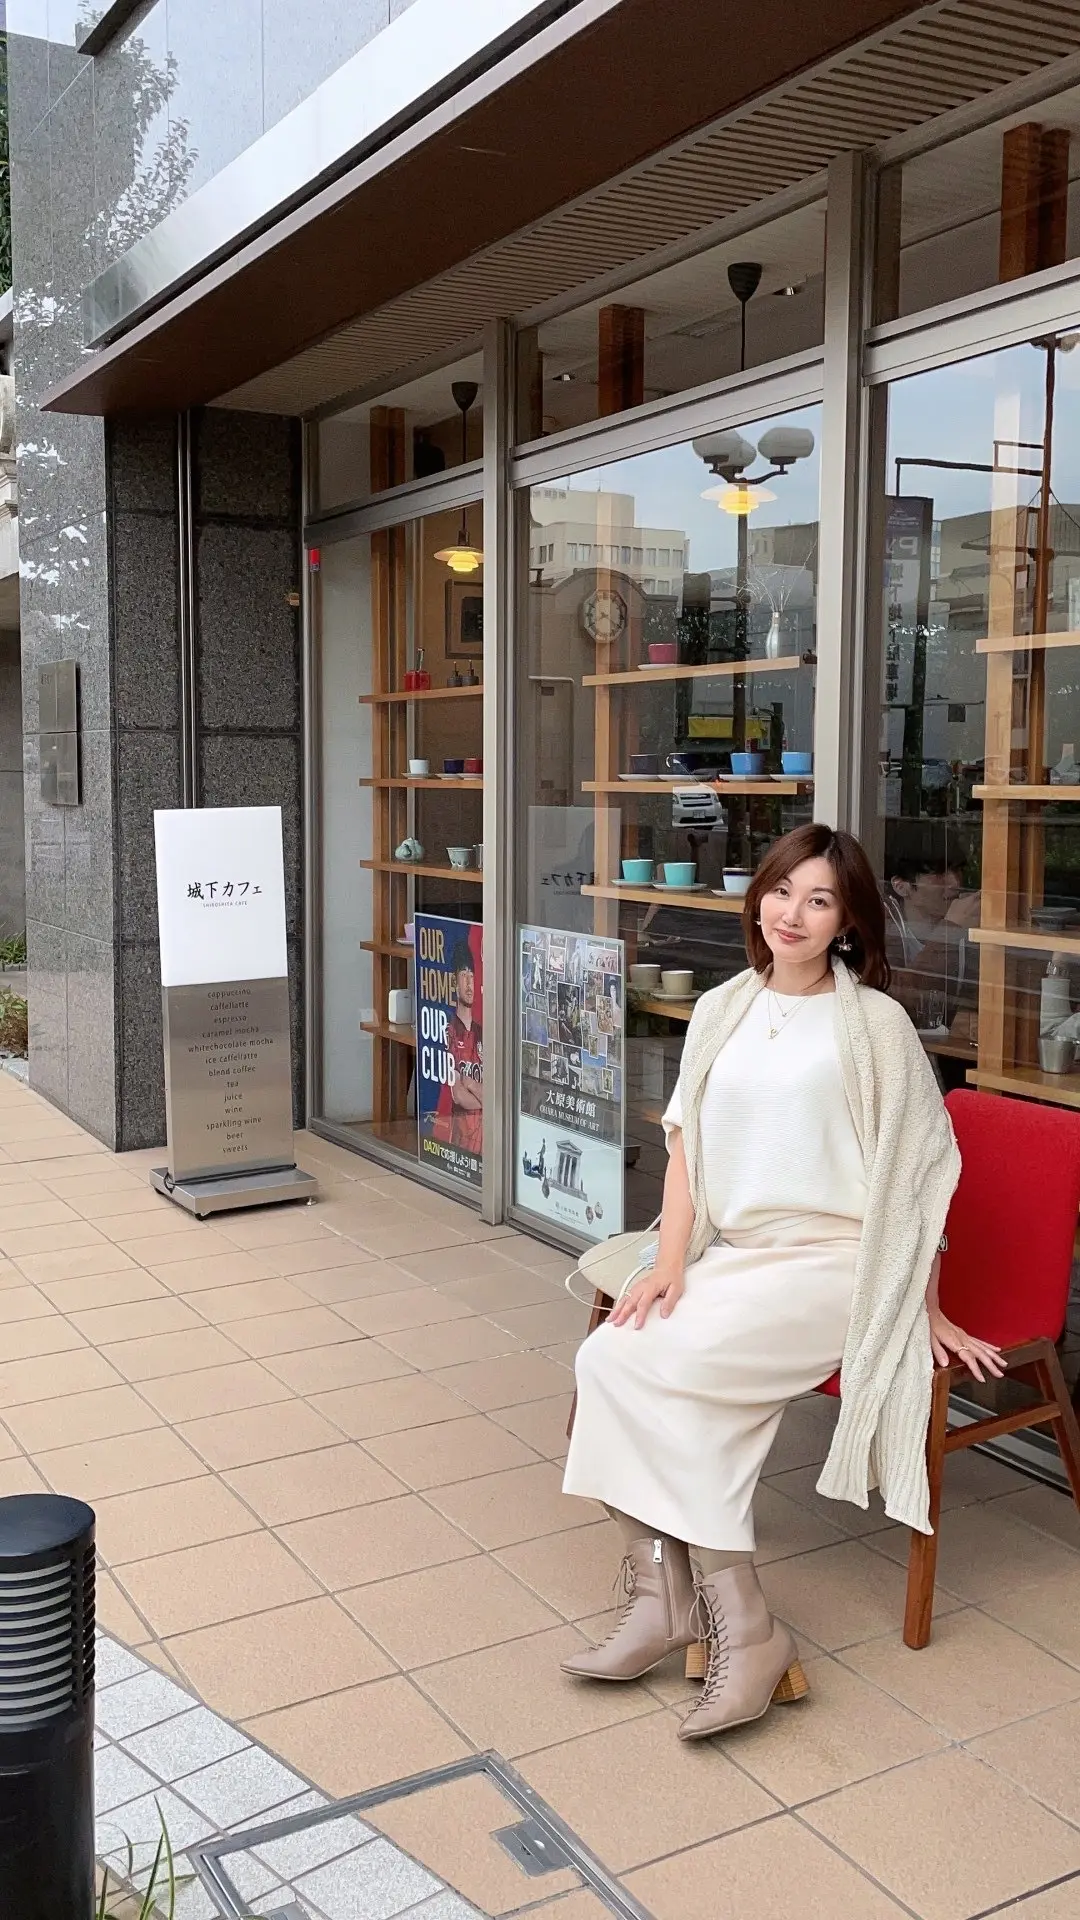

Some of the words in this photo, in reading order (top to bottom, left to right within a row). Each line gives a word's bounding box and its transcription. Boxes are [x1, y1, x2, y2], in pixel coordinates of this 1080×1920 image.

[187, 881, 262, 900] 城下カフェ
[420, 927, 445, 964] OUR
[420, 967, 457, 1007] HOME
[214, 1015, 247, 1024] espresso
[202, 1028, 232, 1038] caramel
[235, 1026, 259, 1035] mocha
[421, 1006, 448, 1046] OUR
[249, 1037, 273, 1046] mocha
[208, 1067, 231, 1077] blend
[233, 1065, 256, 1074] coffee
[422, 1045, 456, 1087] CLUB
[224, 1093, 243, 1103] juice
[545, 1089, 597, 1118] 大原美術館
[224, 1106, 243, 1114] wine
[206, 1119, 242, 1131] sparkling
[244, 1116, 262, 1125] wine
[226, 1132, 243, 1140] beer
[222, 1145, 248, 1154] sweets
